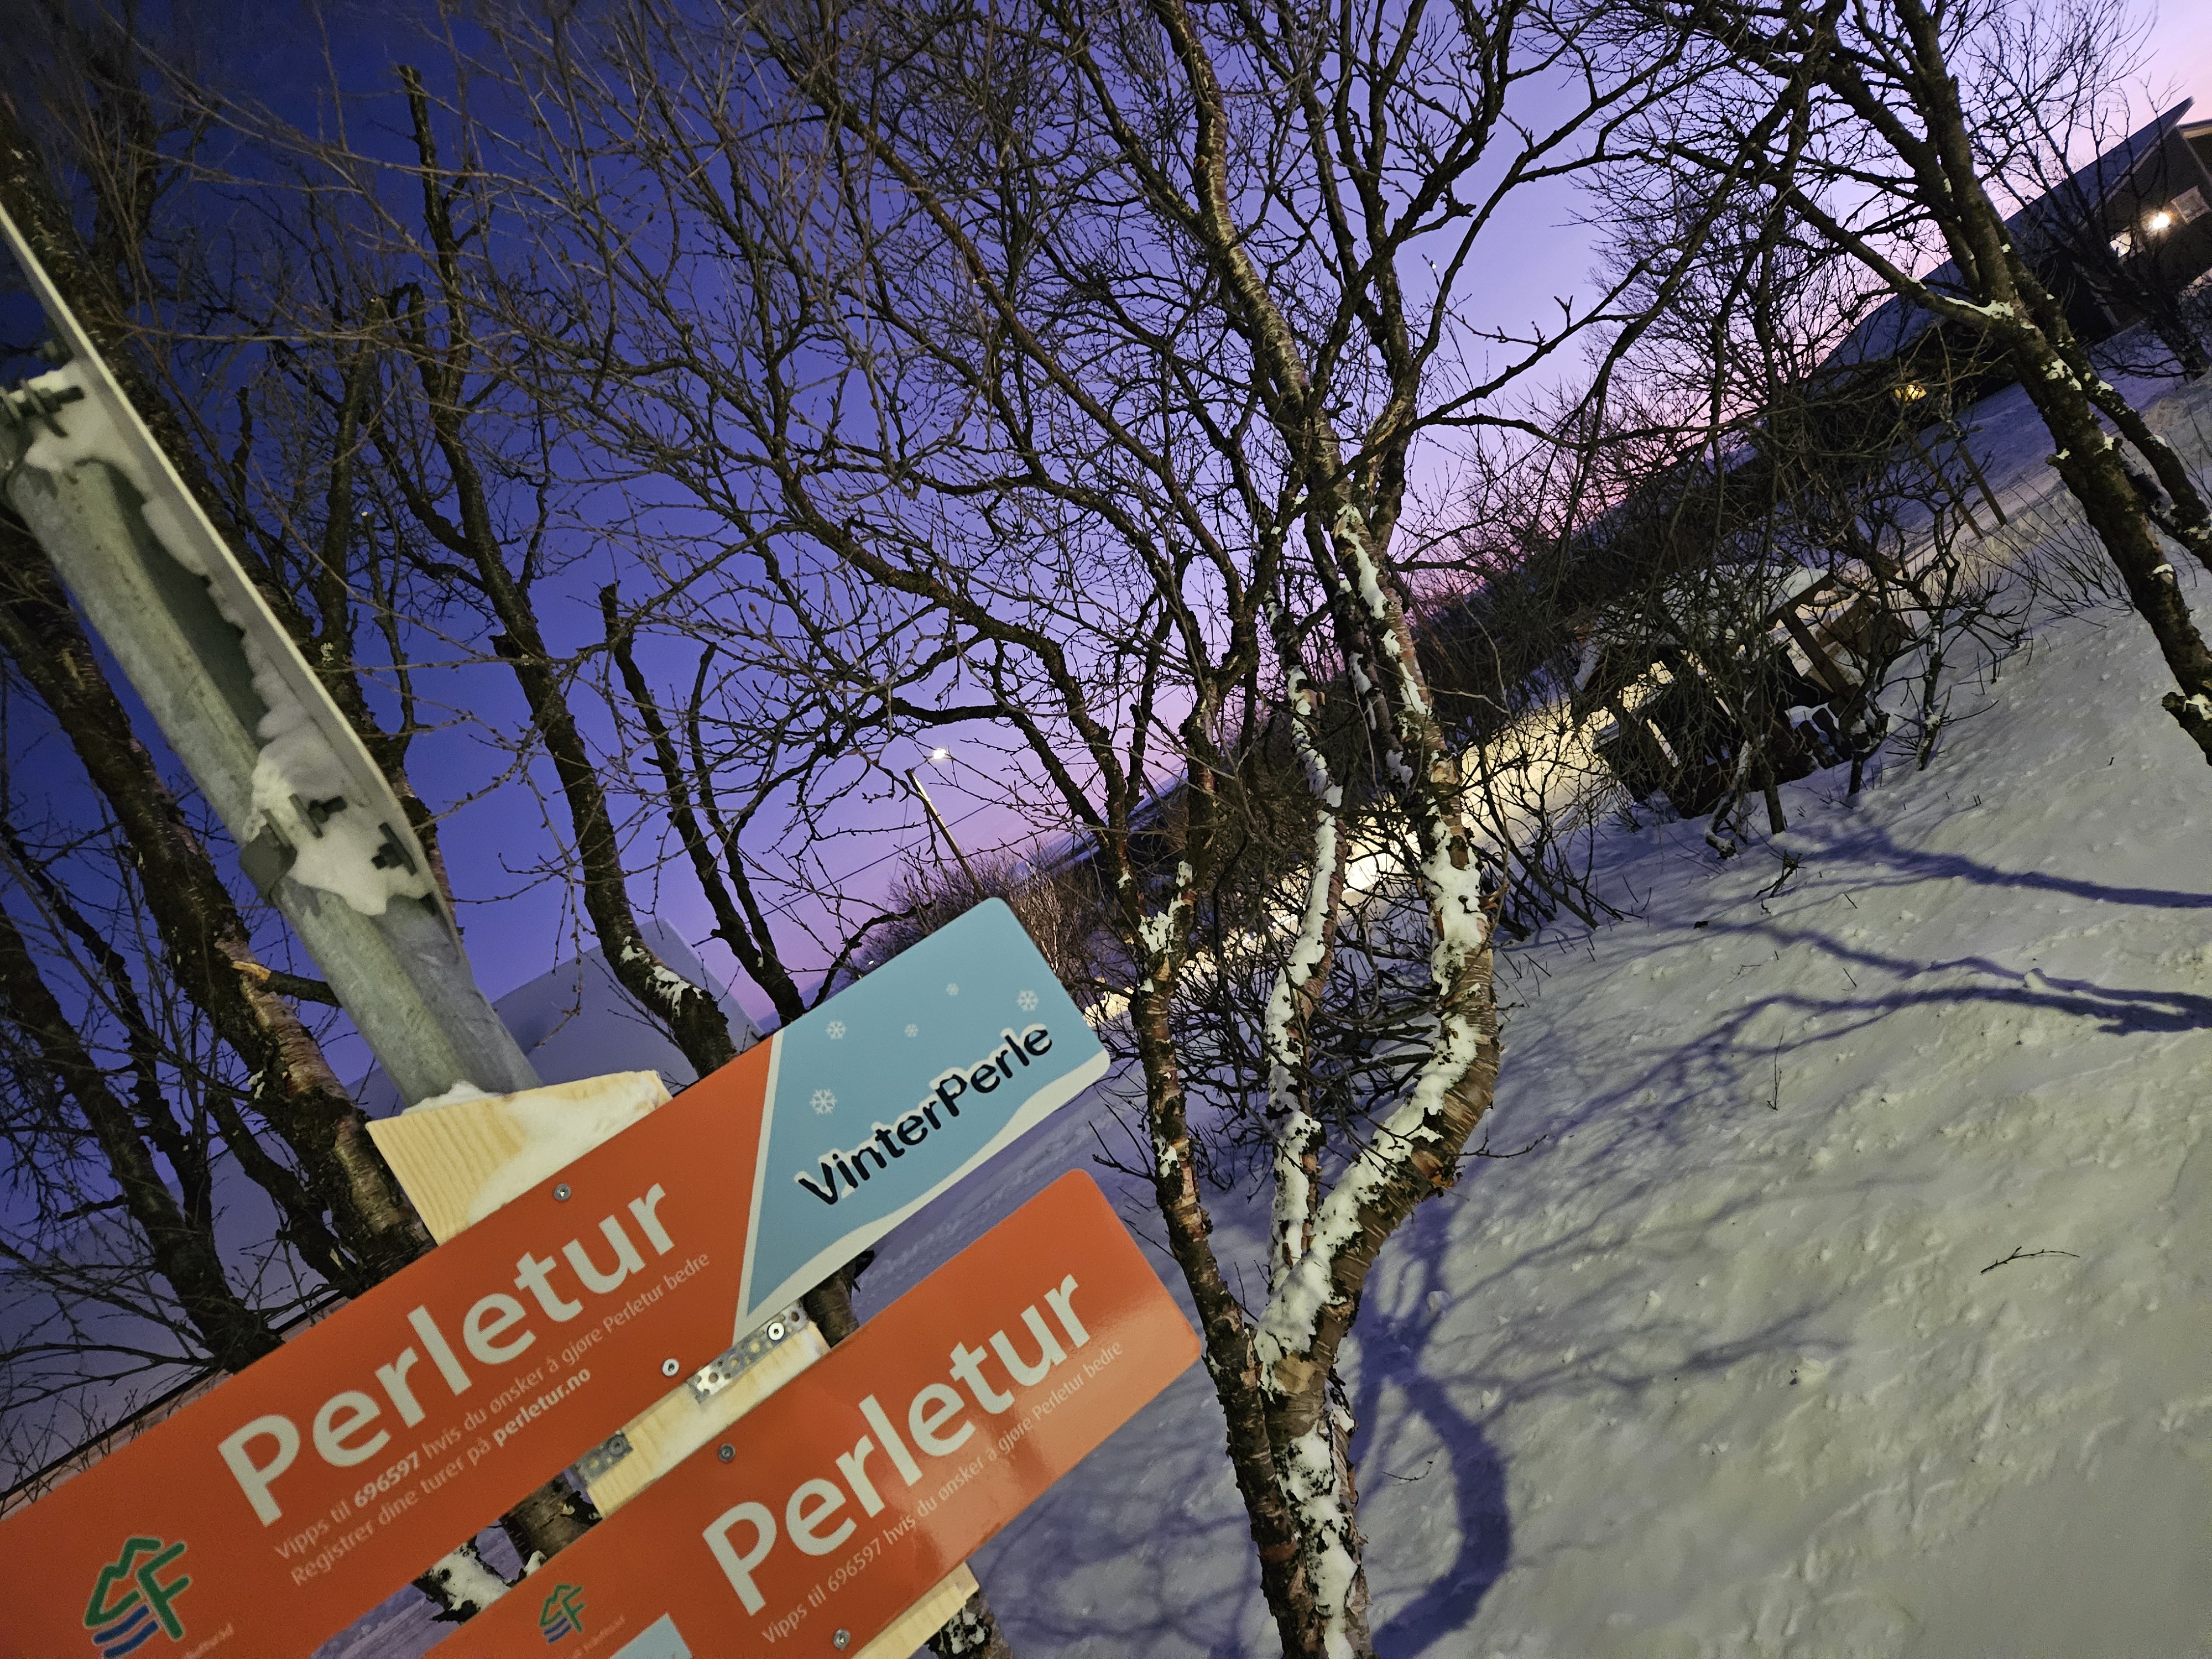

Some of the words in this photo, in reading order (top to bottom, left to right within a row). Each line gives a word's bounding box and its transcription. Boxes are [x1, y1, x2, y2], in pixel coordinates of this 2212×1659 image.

[797, 1026, 1052, 1205] VinterPerle
[217, 1182, 675, 1528] Perletur
[274, 1519, 329, 1559] Vipps
[330, 1498, 352, 1523] til
[354, 1450, 420, 1508] 696597
[421, 1426, 462, 1459] hvis
[464, 1408, 488, 1431] du
[489, 1367, 544, 1414] ønsker
[546, 1354, 560, 1373] å
[561, 1328, 603, 1366] gjøre
[603, 1284, 664, 1333] Perletur
[664, 1253, 710, 1290] bedre
[290, 1521, 375, 1587] Registrer
[378, 1490, 420, 1525] dine
[420, 1455, 465, 1494] turer
[467, 1437, 492, 1465] på
[493, 1368, 591, 1447] perletur.no
[702, 1274, 1091, 1617] Perletur
[761, 1604, 807, 1644] Vipps
[807, 1583, 826, 1608] til
[827, 1537, 881, 1592] 696597
[883, 1515, 916, 1545] hvis
[917, 1495, 937, 1517] du
[938, 1456, 984, 1501] ønsker
[998, 1417, 1033, 1454] gjøre
[1032, 1373, 1084, 1421] Perletur
[1082, 1342, 1123, 1378] bedre
